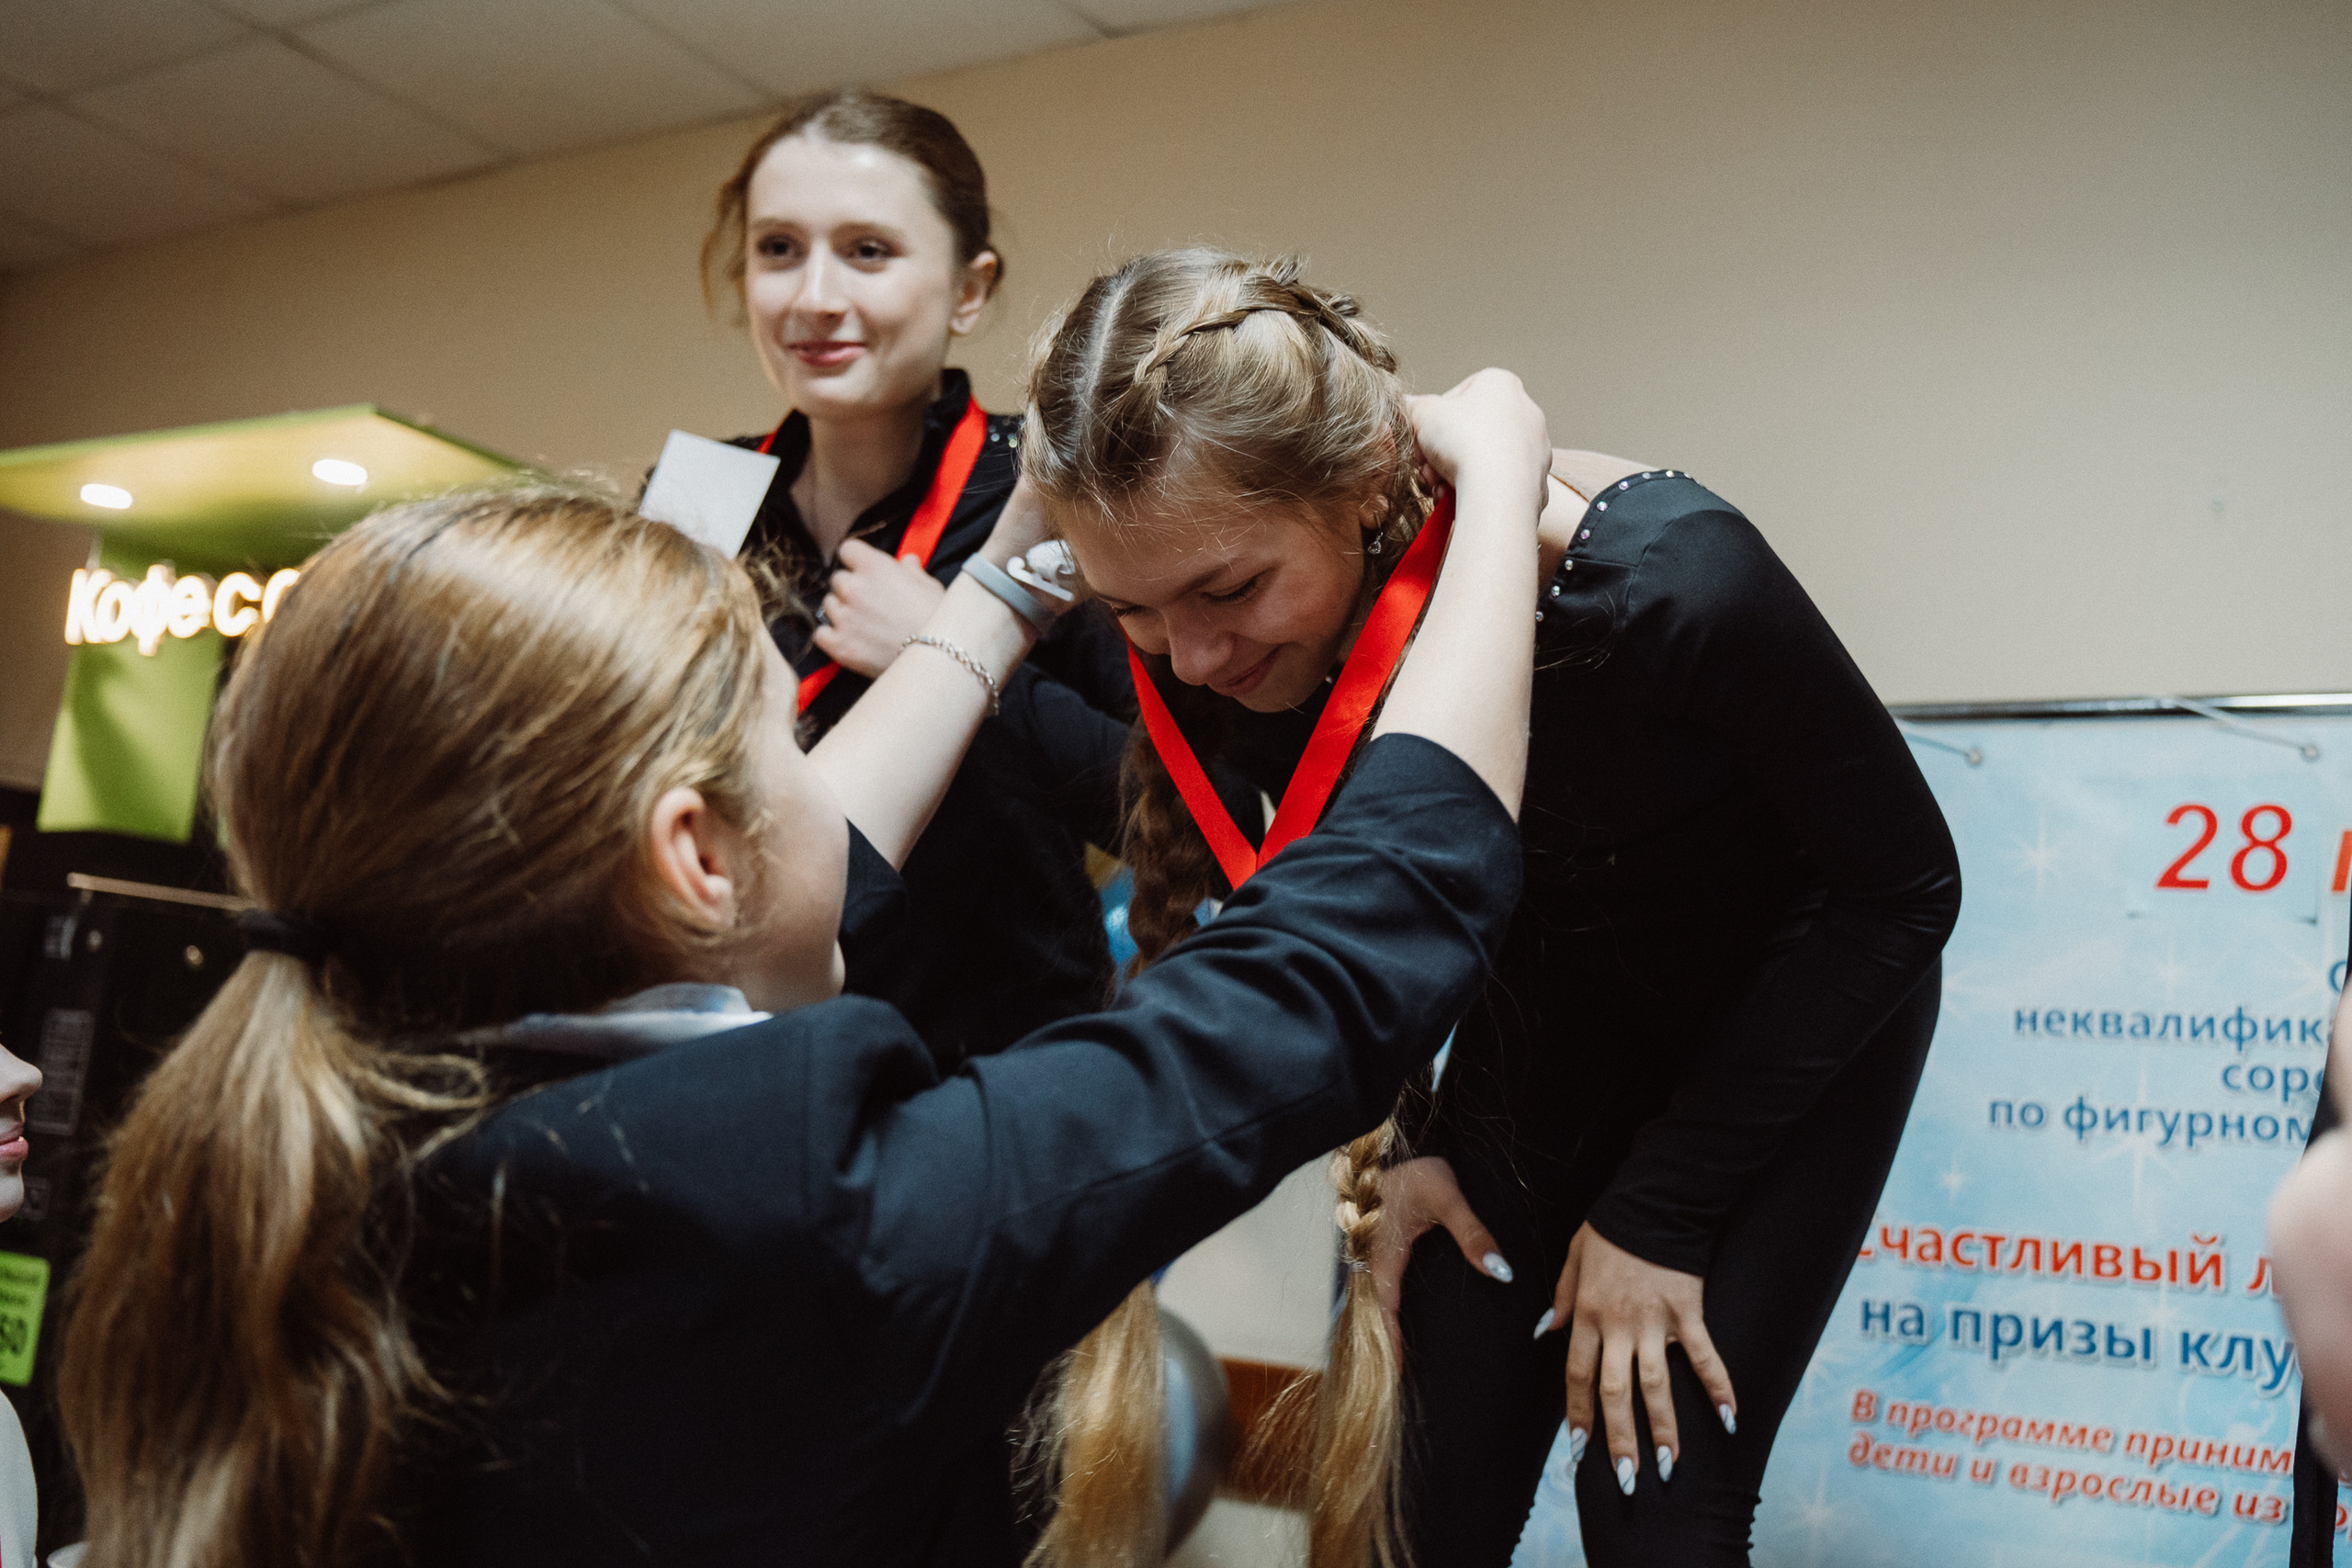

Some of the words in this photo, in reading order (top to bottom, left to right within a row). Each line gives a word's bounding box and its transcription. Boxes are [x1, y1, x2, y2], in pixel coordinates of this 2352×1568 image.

[2155, 804, 2292, 892] 28
[2014, 1006, 2331, 1052] неквалифик
[1988, 1100, 2045, 1128] по
[1859, 1225, 2222, 1288] частливый
[1861, 1300, 1925, 1337] на
[1952, 1310, 2152, 1361] призы
[1851, 1388, 1876, 1423] В
[1886, 1401, 2112, 1452] программе
[2125, 1430, 2292, 1472] приним
[1848, 1430, 1956, 1478] дети
[1970, 1458, 1996, 1483] и
[2009, 1462, 2219, 1514] взрослые
[2233, 1492, 2282, 1522] из
